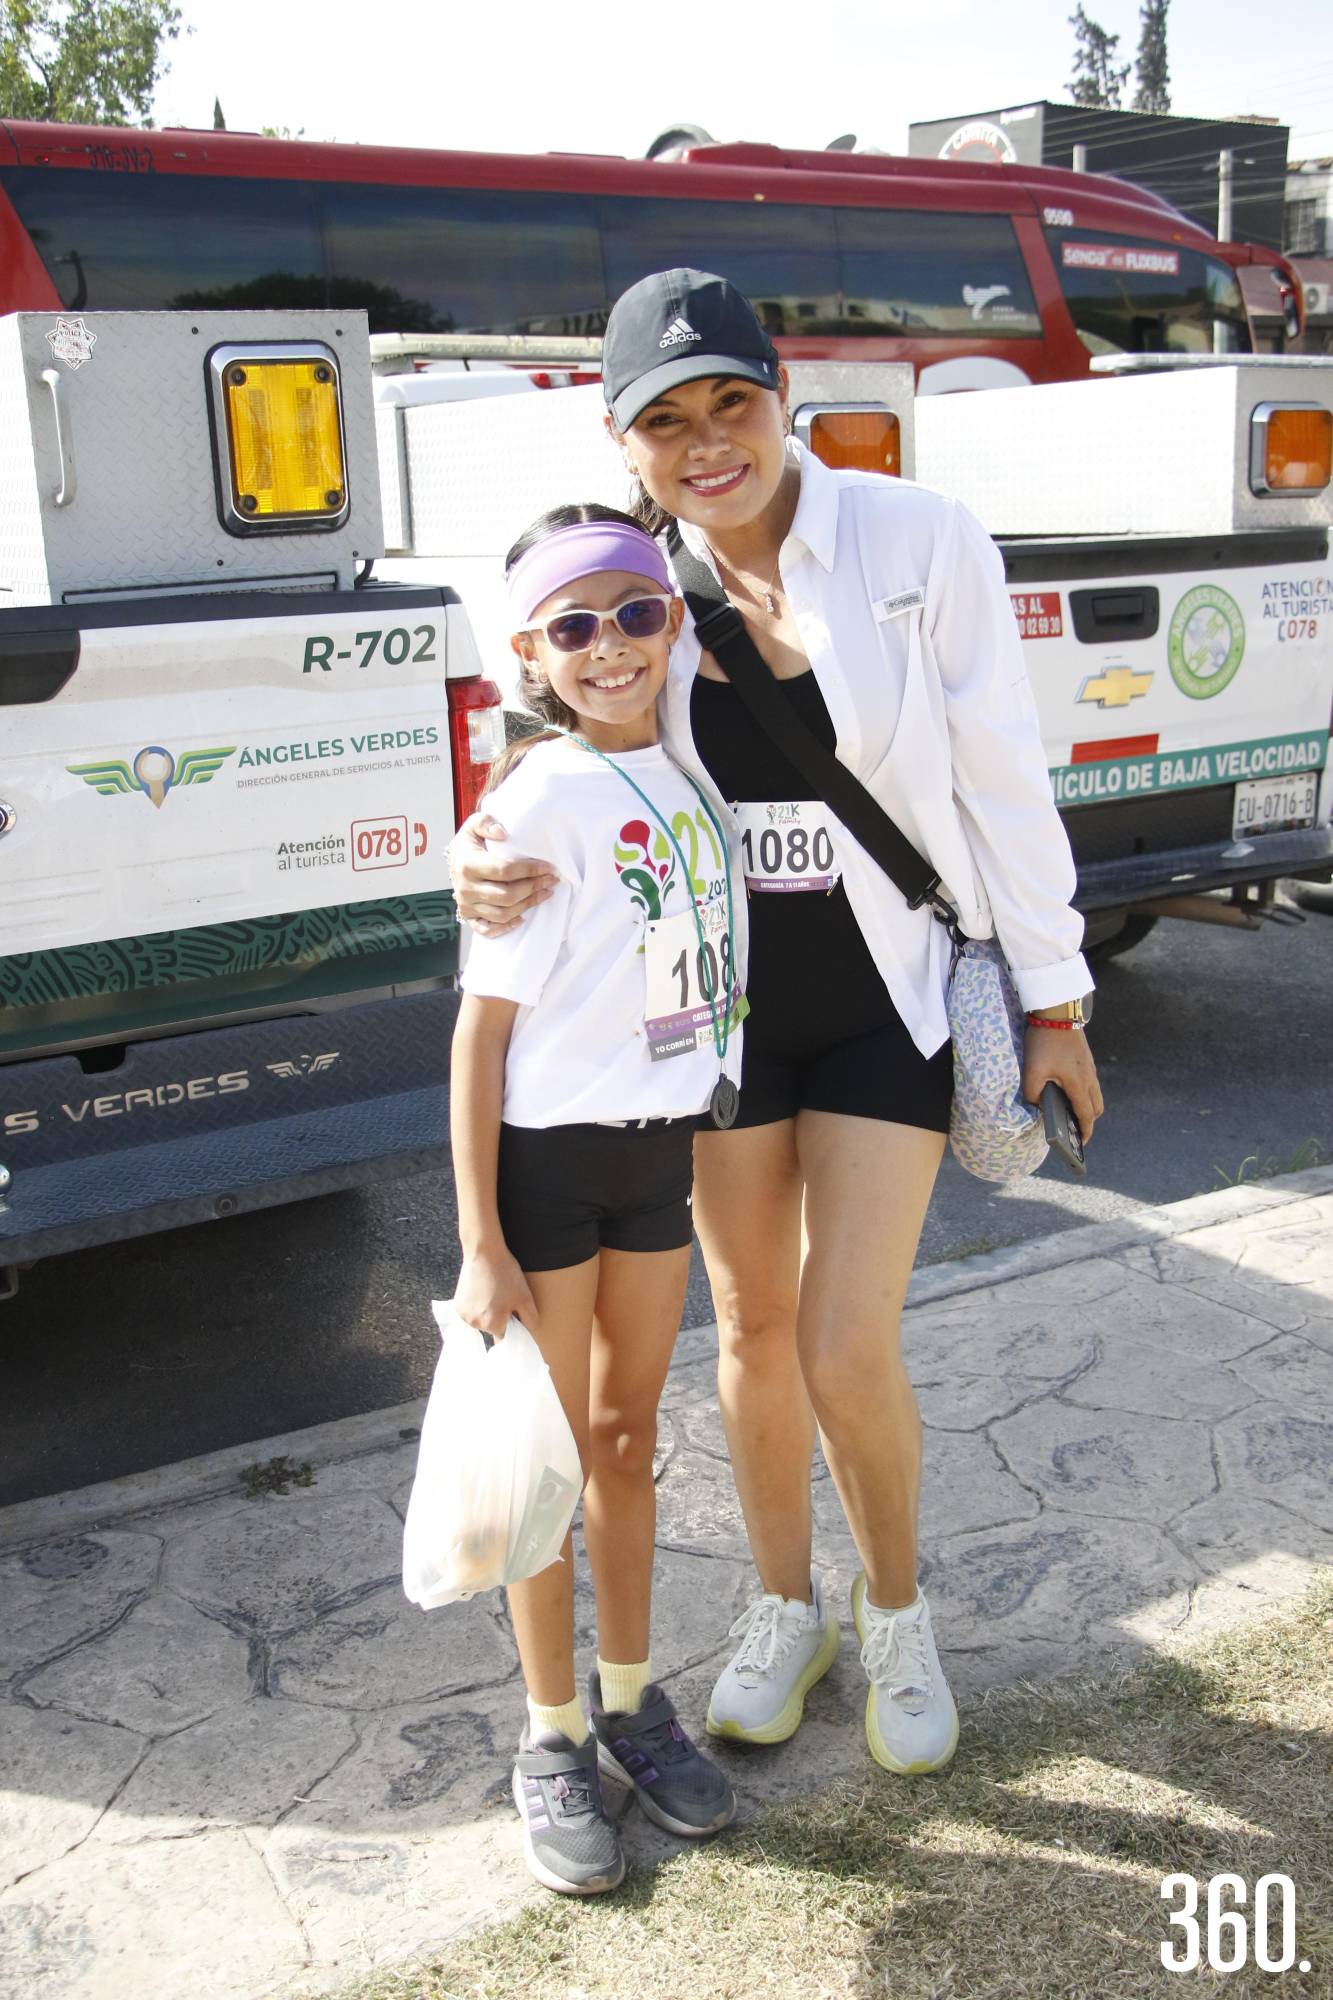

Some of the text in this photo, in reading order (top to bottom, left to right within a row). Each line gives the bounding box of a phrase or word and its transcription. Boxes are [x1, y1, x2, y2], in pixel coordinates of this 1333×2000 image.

[659, 331, 702, 349] adidas
[1029, 596, 1045, 614] AL
[1263, 603, 1279, 618] AL
[1287, 619, 1318, 639] 078
[302, 624, 437, 674] R-702
[238, 726, 439, 768] ÁNGELES VERDES
[237, 755, 441, 788] DIRECCIÓN GENERAL DE SERVICIOS AL TURISTA
[1126, 763, 1154, 791] DE
[1159, 753, 1211, 785] BAJA
[1215, 741, 1321, 778] VELOCIDAD
[277, 827, 402, 860] Atención 078
[741, 826, 834, 874] 1080
[278, 852, 345, 871] al turista
[655, 1045, 666, 1054] YO
[685, 1036, 694, 1046] EN
[62, 1070, 250, 1123] VERDES
